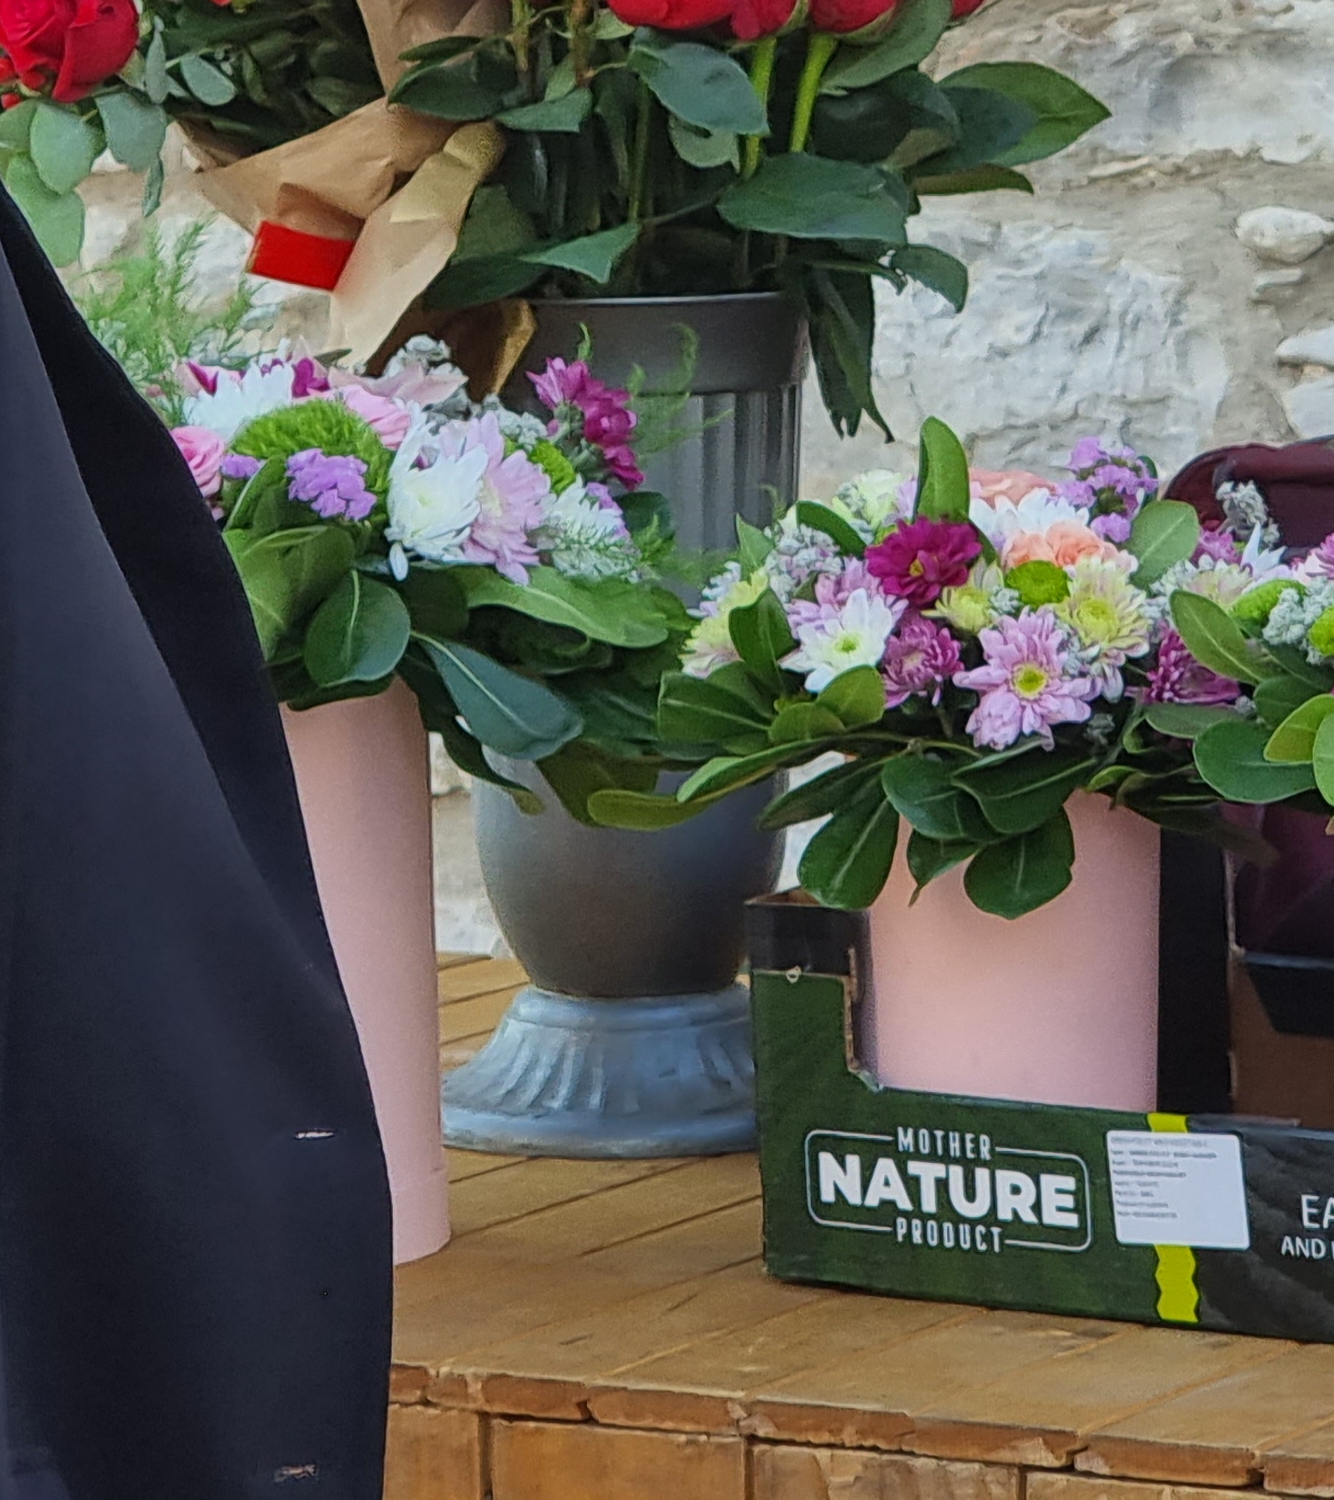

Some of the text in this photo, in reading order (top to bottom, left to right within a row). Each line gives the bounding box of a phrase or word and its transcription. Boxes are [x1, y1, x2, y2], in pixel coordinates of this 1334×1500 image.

[897, 1126, 991, 1161] MOTHER
[818, 1151, 1079, 1228] NATURE
[896, 1217, 1003, 1253] PRODUCT
[1281, 1235, 1326, 1259] AND
